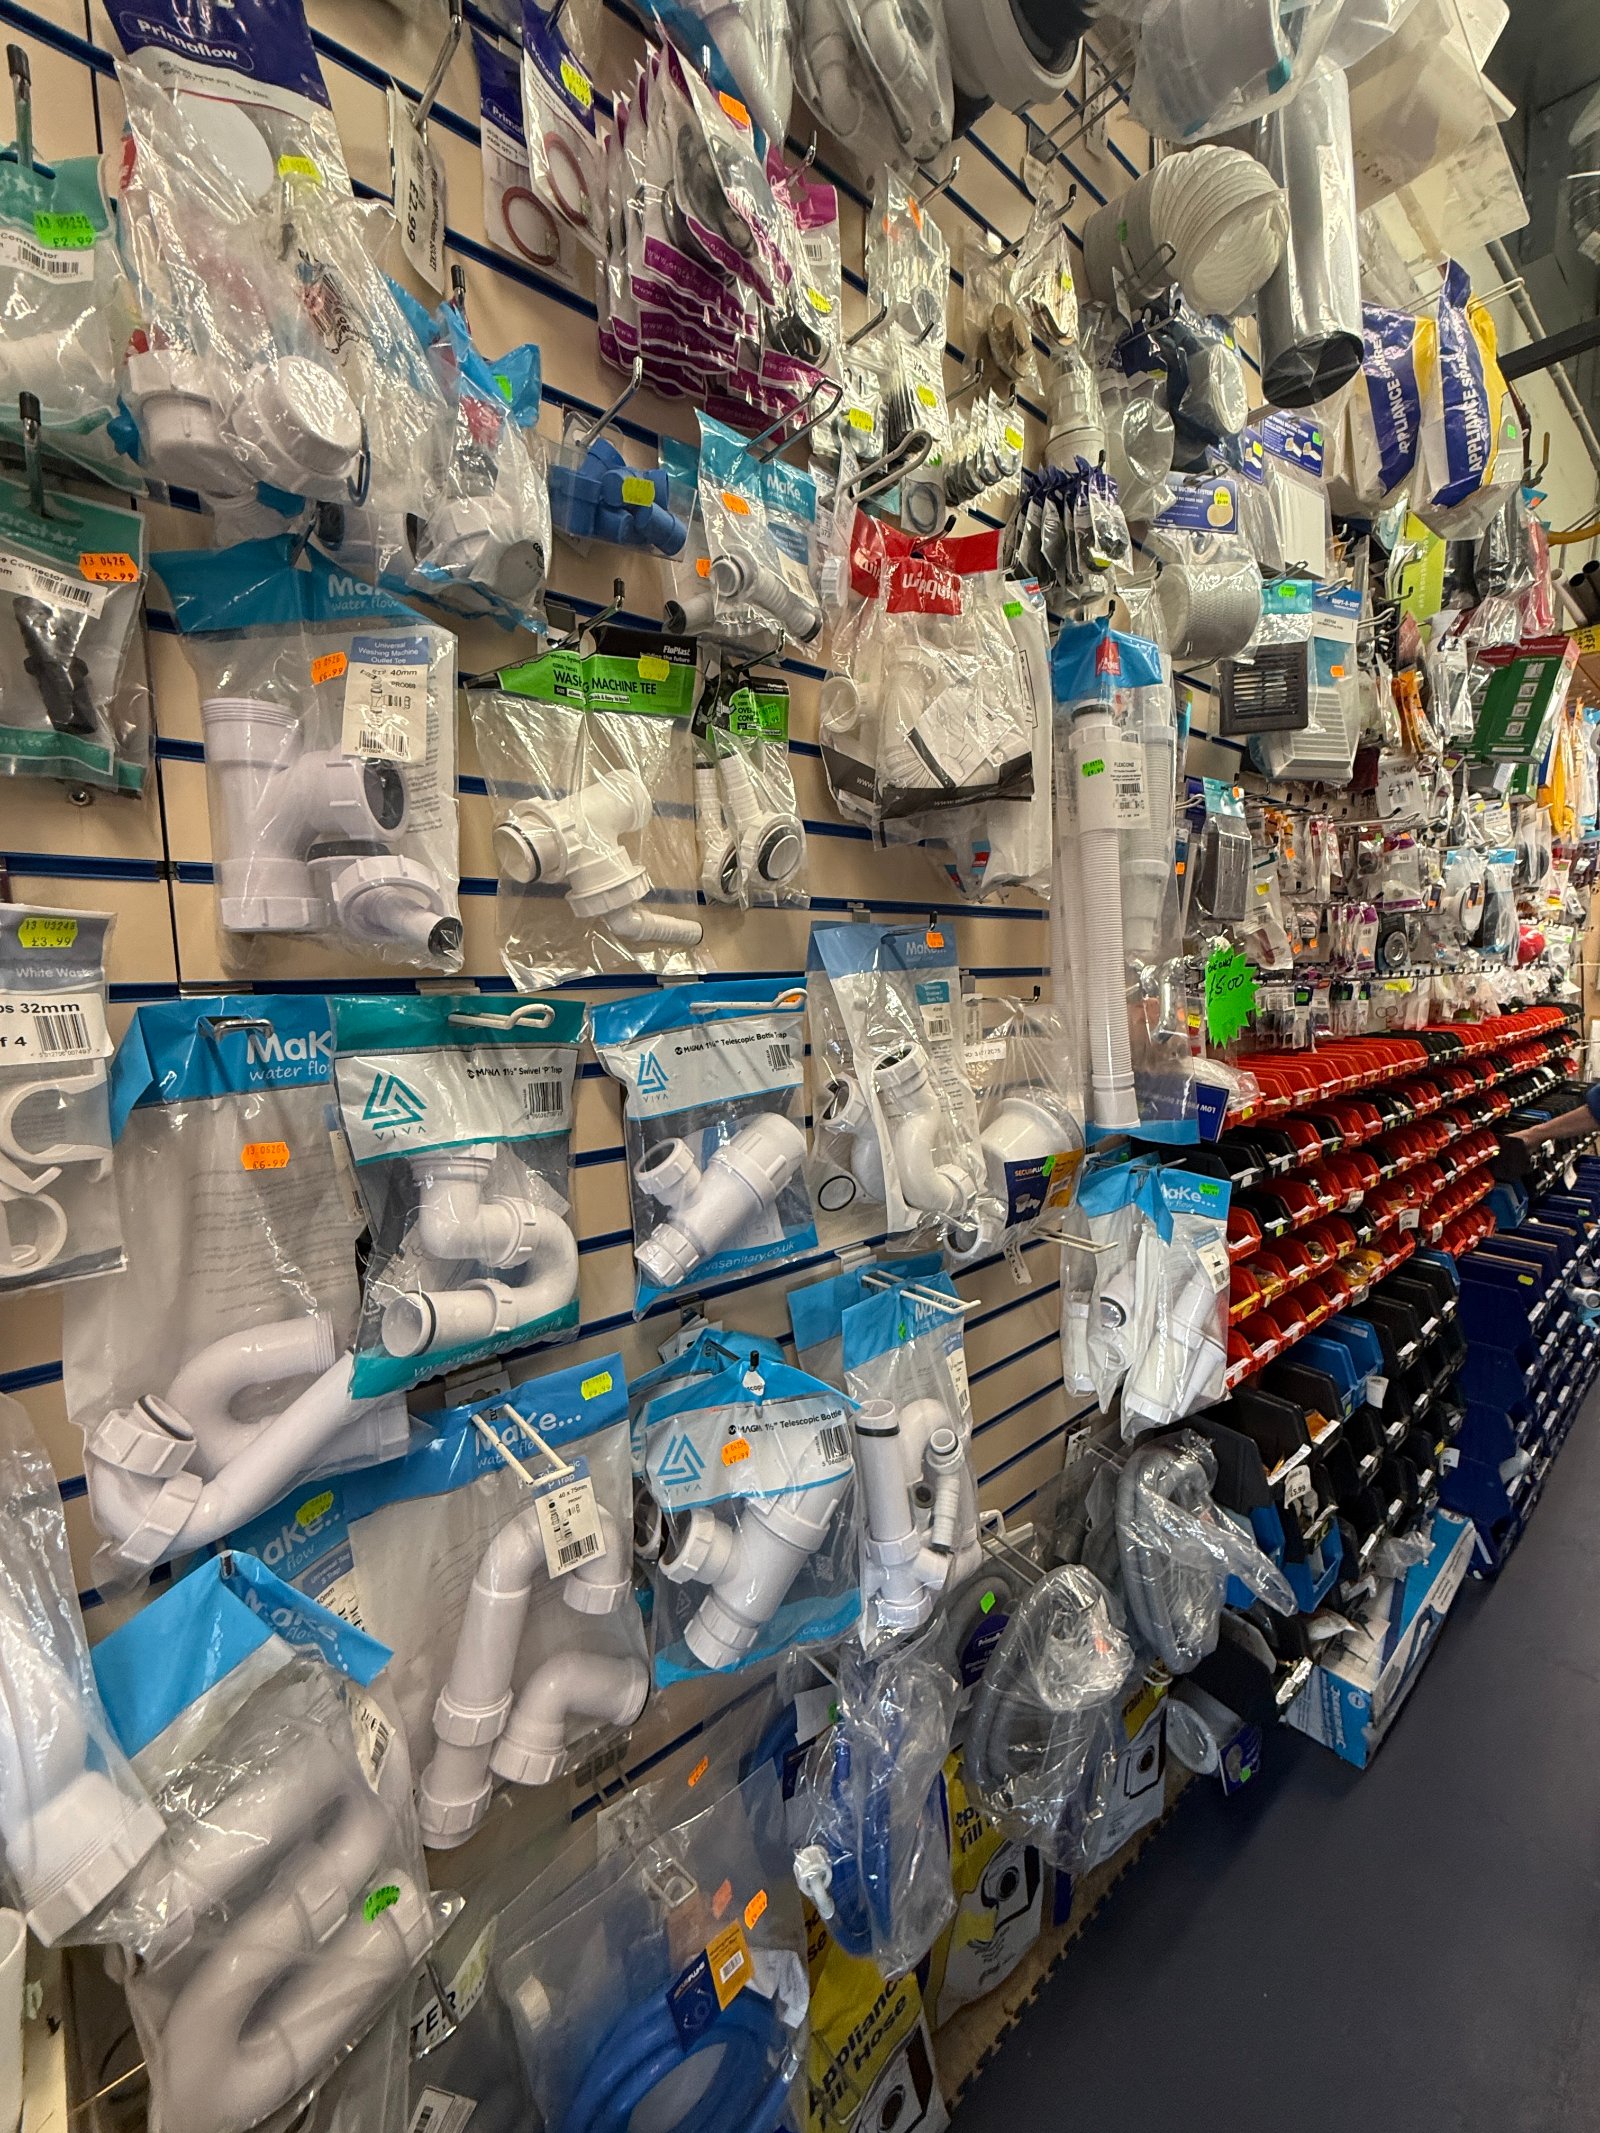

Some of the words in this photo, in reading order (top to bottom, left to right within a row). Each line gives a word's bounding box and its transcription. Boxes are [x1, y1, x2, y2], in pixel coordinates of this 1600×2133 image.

[137, 18, 238, 61] Primaflow
[9, 558, 64, 582] Connector
[374, 641, 406, 649] Universal
[662, 645, 691, 656] FloPlast
[358, 646, 390, 658] Washing
[390, 648, 419, 657] Machine
[370, 656, 393, 665] Outlet
[394, 657, 407, 665] Tee
[389, 668, 418, 678] 40mm
[591, 677, 639, 694] MACHINE
[640, 681, 657, 695] TEE
[25, 921, 36, 930] 13
[31, 936, 71, 947] £3.99
[15, 967, 54, 978] White
[55, 967, 95, 978] Waste
[20, 1003, 80, 1014] 32mm
[14, 1036, 27, 1047] 4
[720, 1034, 756, 1046] Telescopic
[755, 1031, 774, 1041] Bottle
[250, 1068, 303, 1082] water
[307, 1060, 331, 1076] flo
[518, 1065, 541, 1075] Swivel
[374, 1124, 427, 1142] VIVA
[779, 1415, 820, 1429] Telescopic
[820, 1408, 843, 1420] Bottle
[558, 1491, 566, 1499] 40
[663, 1483, 703, 1497] VIVA
[853, 1995, 907, 2073] Hose
